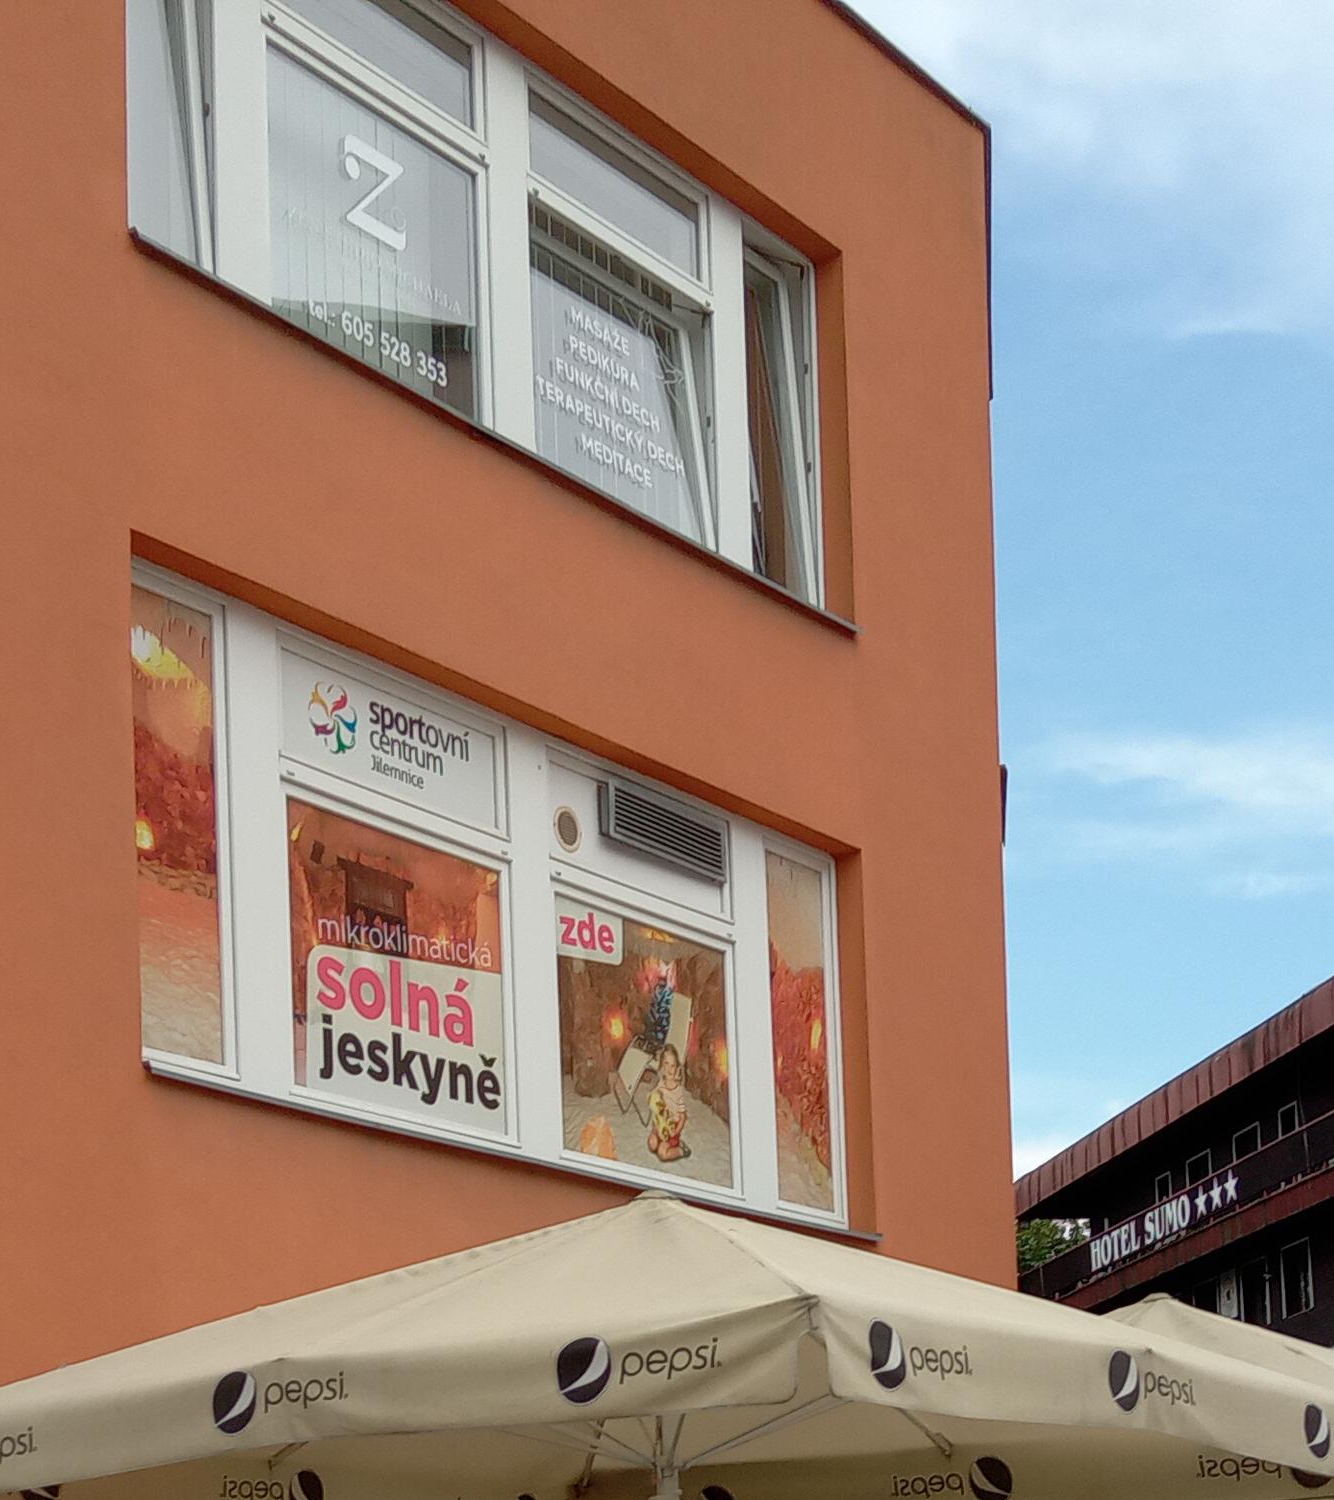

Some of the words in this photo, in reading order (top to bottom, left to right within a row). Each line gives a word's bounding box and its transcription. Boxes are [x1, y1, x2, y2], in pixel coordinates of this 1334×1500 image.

[341, 310, 374, 347] 605
[380, 331, 412, 367] 528
[417, 351, 448, 387] 353
[622, 396, 661, 433] DECH
[581, 432, 653, 488] MEDITACE
[647, 440, 685, 478] DECH
[369, 701, 469, 761] sportovní
[370, 730, 443, 776] centrum
[371, 754, 425, 789] Jilemnice
[318, 915, 492, 968] mikroklimatická
[559, 912, 614, 954] zde
[317, 956, 474, 1047] solná
[319, 1013, 501, 1110] jeskyně
[1090, 1219, 1142, 1272] HOTEL
[1144, 1194, 1191, 1245] SUMO
[619, 1336, 719, 1384] pepsi
[909, 1344, 968, 1381] pepsi
[264, 1371, 346, 1413] pepsi
[1143, 1368, 1194, 1405] pepsi
